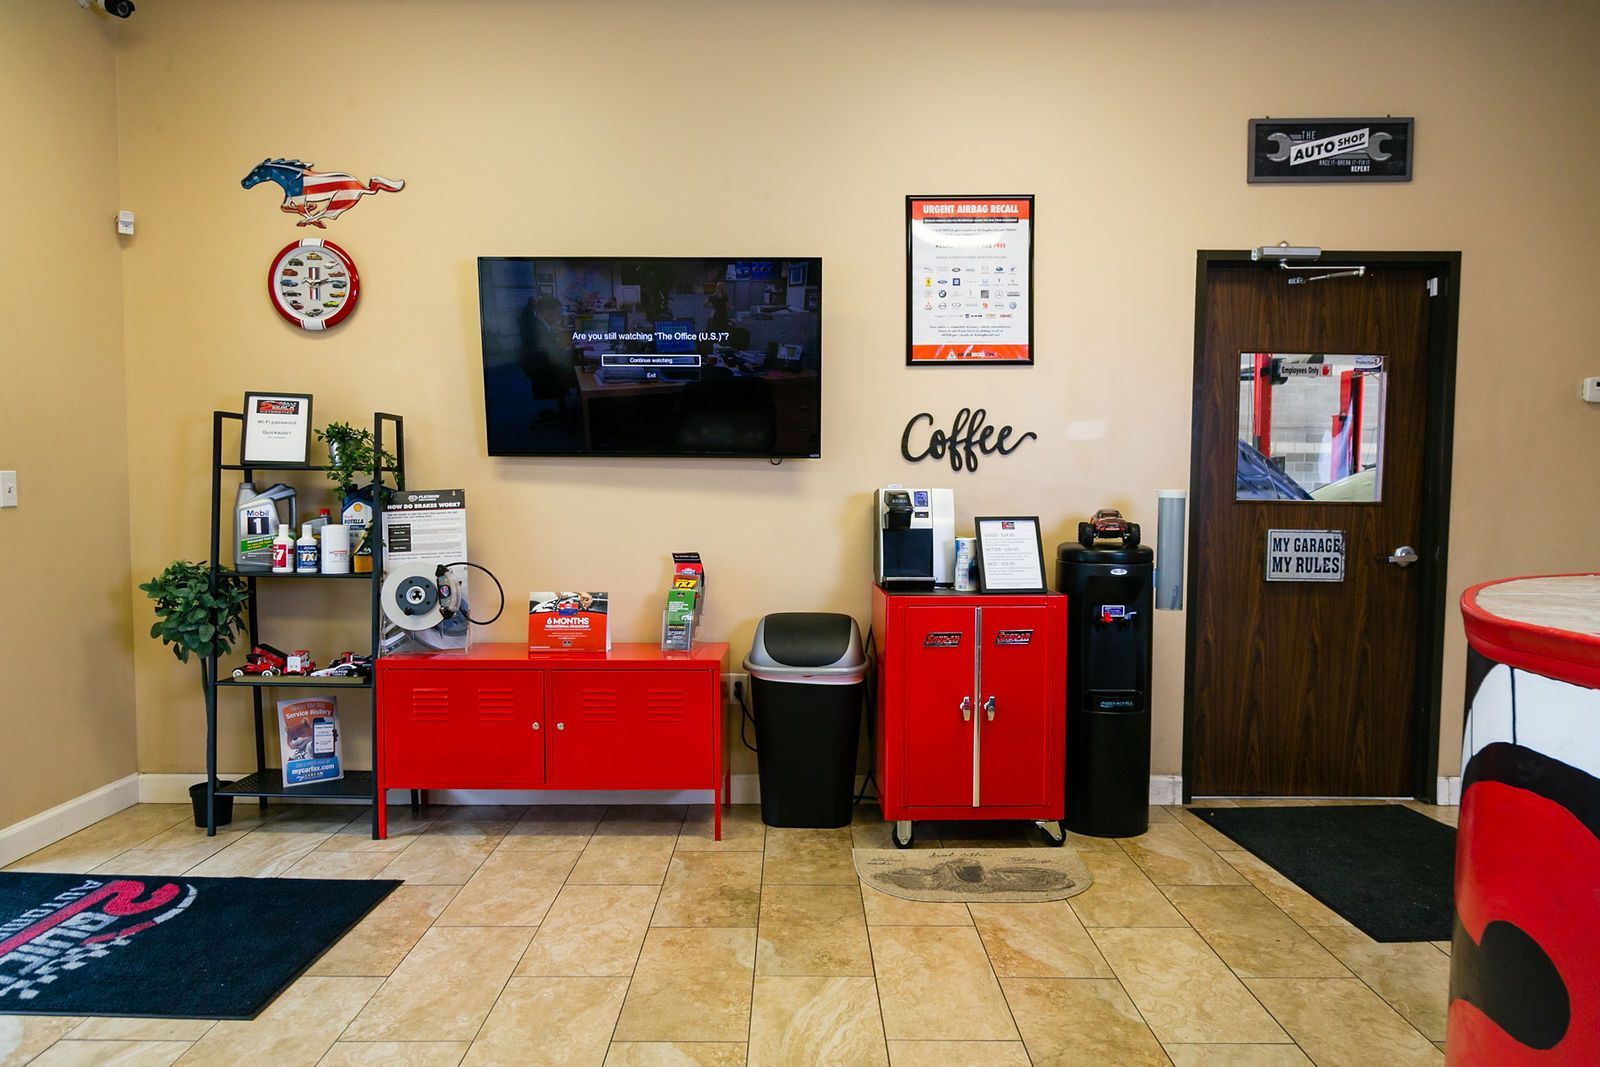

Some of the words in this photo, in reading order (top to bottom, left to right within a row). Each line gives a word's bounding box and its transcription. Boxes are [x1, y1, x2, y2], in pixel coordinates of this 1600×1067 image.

[1301, 130, 1317, 140] THE
[1293, 141, 1335, 161] AUTO
[1337, 133, 1366, 147] SHOP
[1351, 165, 1370, 173] REPEAT
[923, 204, 955, 214] URGENT
[956, 204, 987, 214] AIRBAG
[989, 204, 1018, 214] RECALL
[572, 332, 586, 341] Are
[588, 333, 602, 343] you
[604, 332, 617, 341] still
[619, 332, 652, 343] watching
[674, 332, 697, 341] Office
[1282, 366, 1308, 375] Employees
[1308, 366, 1319, 375] Only
[901, 407, 1037, 472] Coffee
[253, 517, 262, 534] 1
[1272, 537, 1290, 552] MY
[1293, 537, 1341, 553] GARAGE
[1272, 556, 1292, 573] MY
[1295, 556, 1340, 574] RULES
[546, 617, 553, 625] 6
[553, 617, 589, 625] MONTHS
[285, 710, 309, 719] Service
[292, 764, 335, 775] mycarfax.com
